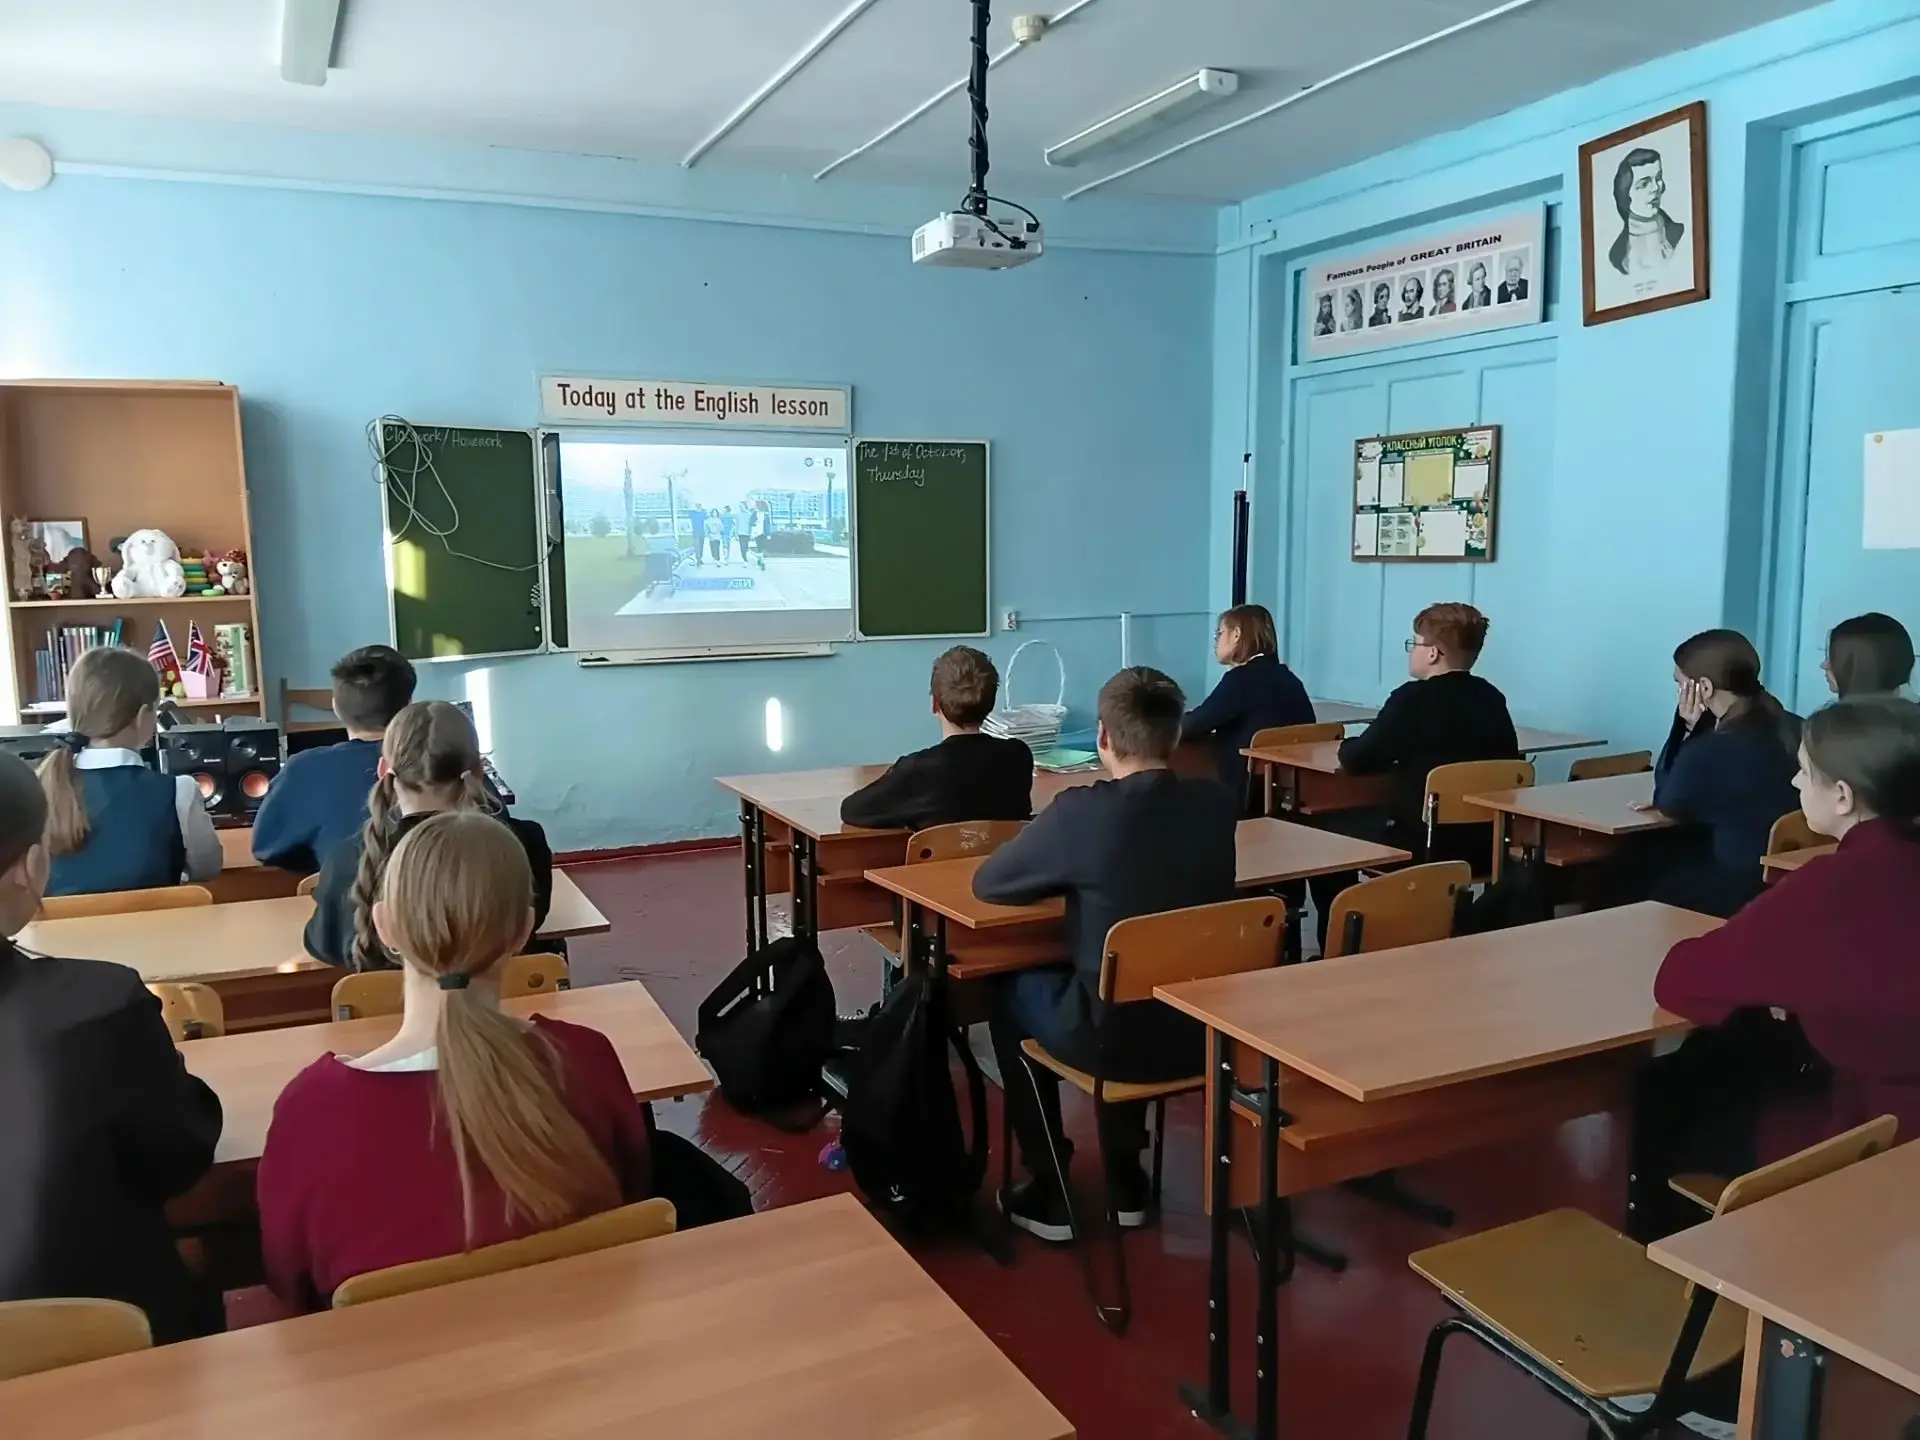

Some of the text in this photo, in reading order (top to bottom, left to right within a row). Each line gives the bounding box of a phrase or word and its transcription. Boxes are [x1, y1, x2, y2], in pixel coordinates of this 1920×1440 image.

[1326, 235, 1502, 281] Famous People of GREAT BRITAIN
[557, 383, 829, 420] Today at the English lesson
[858, 442, 879, 462] The
[901, 443, 914, 460] of
[1386, 436, 1426, 452] КЛАССНЫЙ
[1427, 435, 1457, 448] УГОЛОК
[866, 464, 925, 487] Thursday
